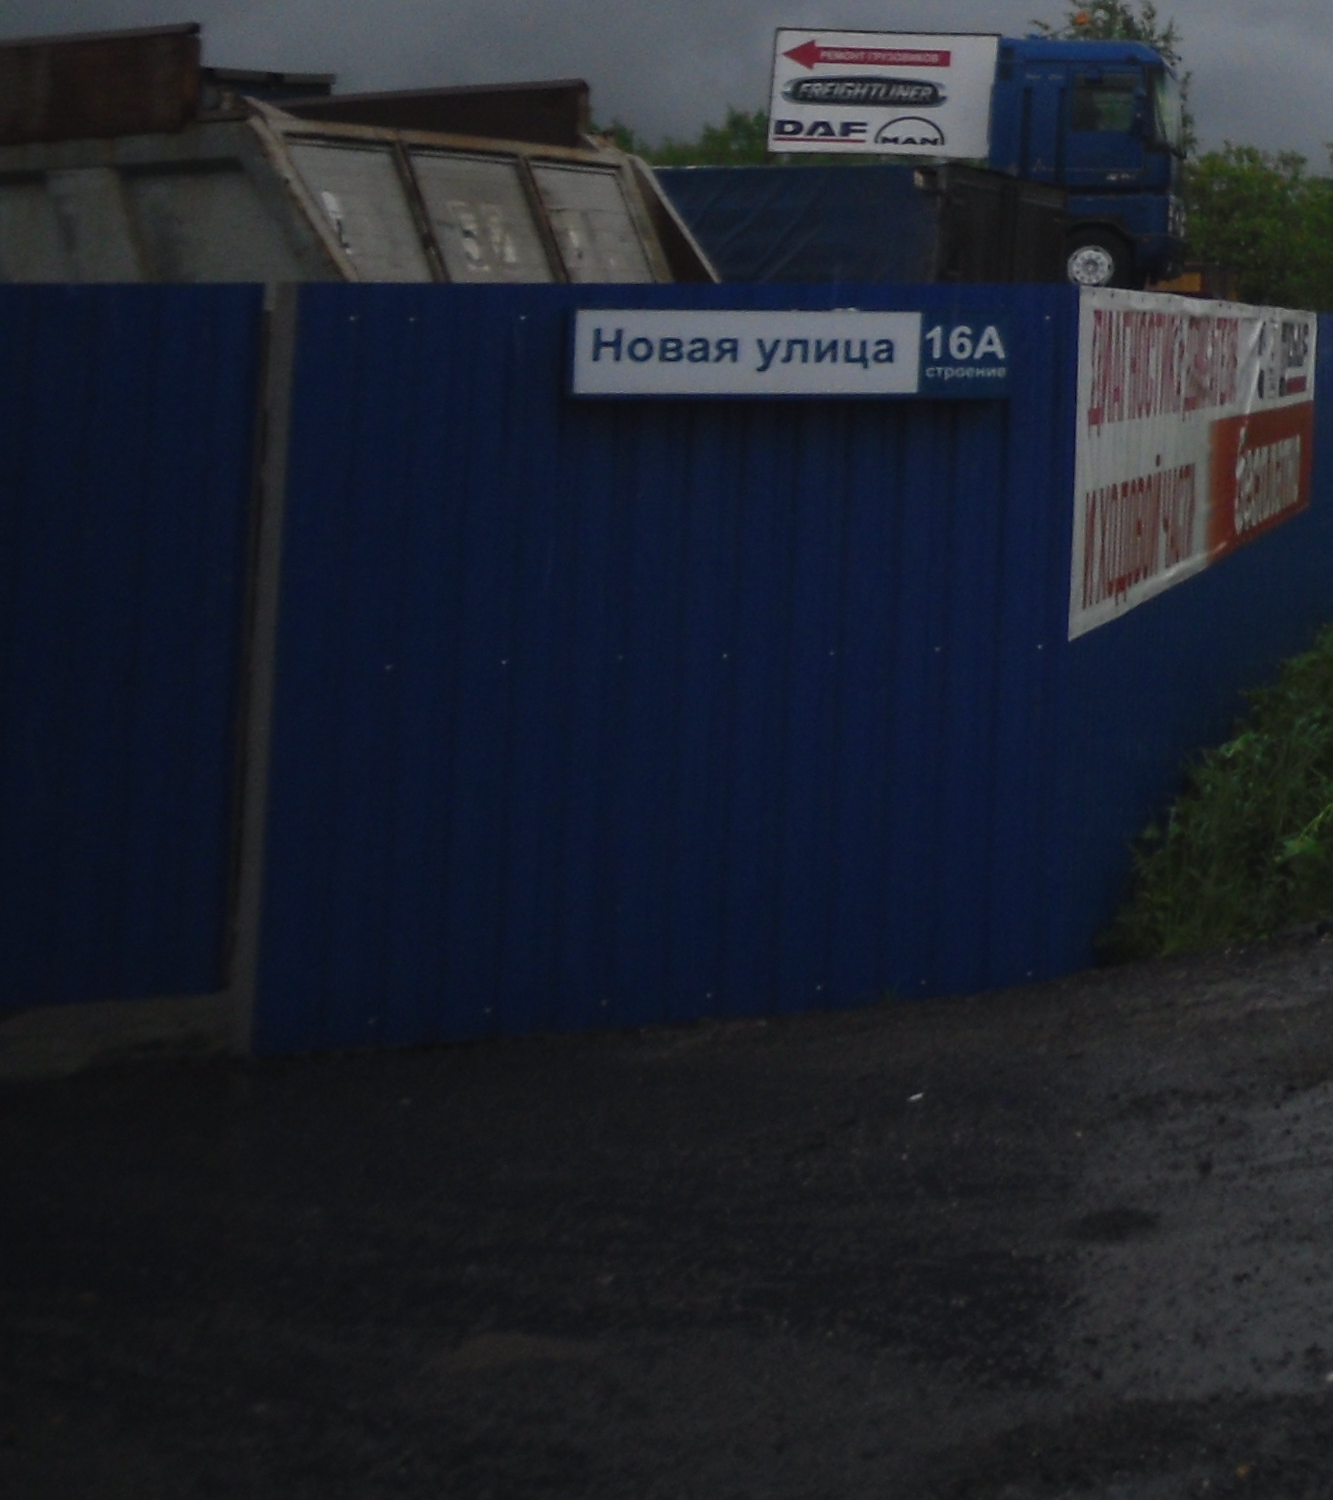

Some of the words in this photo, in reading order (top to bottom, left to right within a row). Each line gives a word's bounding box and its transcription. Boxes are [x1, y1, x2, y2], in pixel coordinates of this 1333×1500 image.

[800, 81, 933, 99] FREIGHTLINER
[774, 119, 868, 137] DAF
[881, 136, 940, 146] MAN
[591, 327, 740, 364] Новая
[755, 337, 896, 373] улица
[925, 366, 1007, 381] строение
